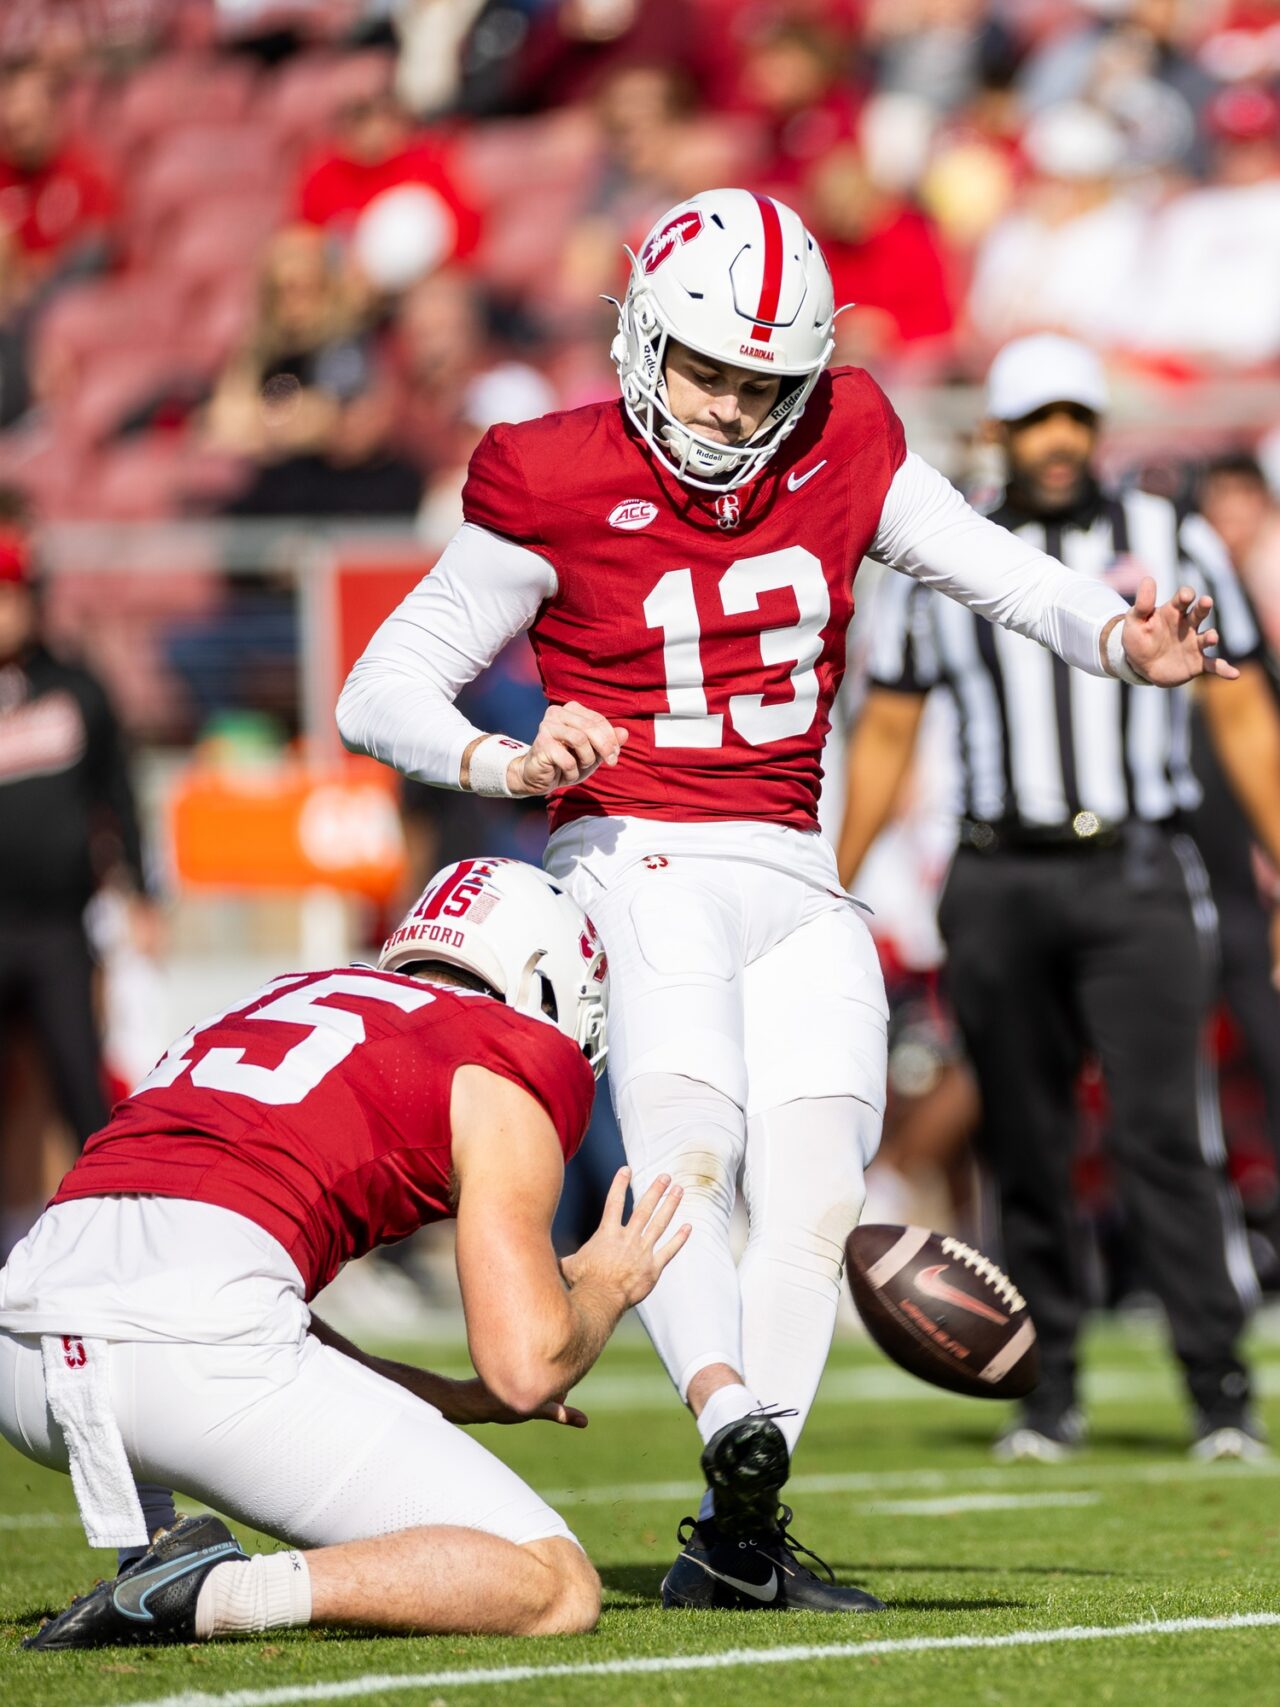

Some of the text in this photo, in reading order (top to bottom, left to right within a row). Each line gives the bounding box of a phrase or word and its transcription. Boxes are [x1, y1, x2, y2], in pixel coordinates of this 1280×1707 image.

[738, 344, 775, 363] CARDINAL
[695, 448, 723, 462] Riddell
[615, 503, 653, 523] ACC
[642, 544, 831, 749] 13
[384, 923, 466, 953] STANFORD
